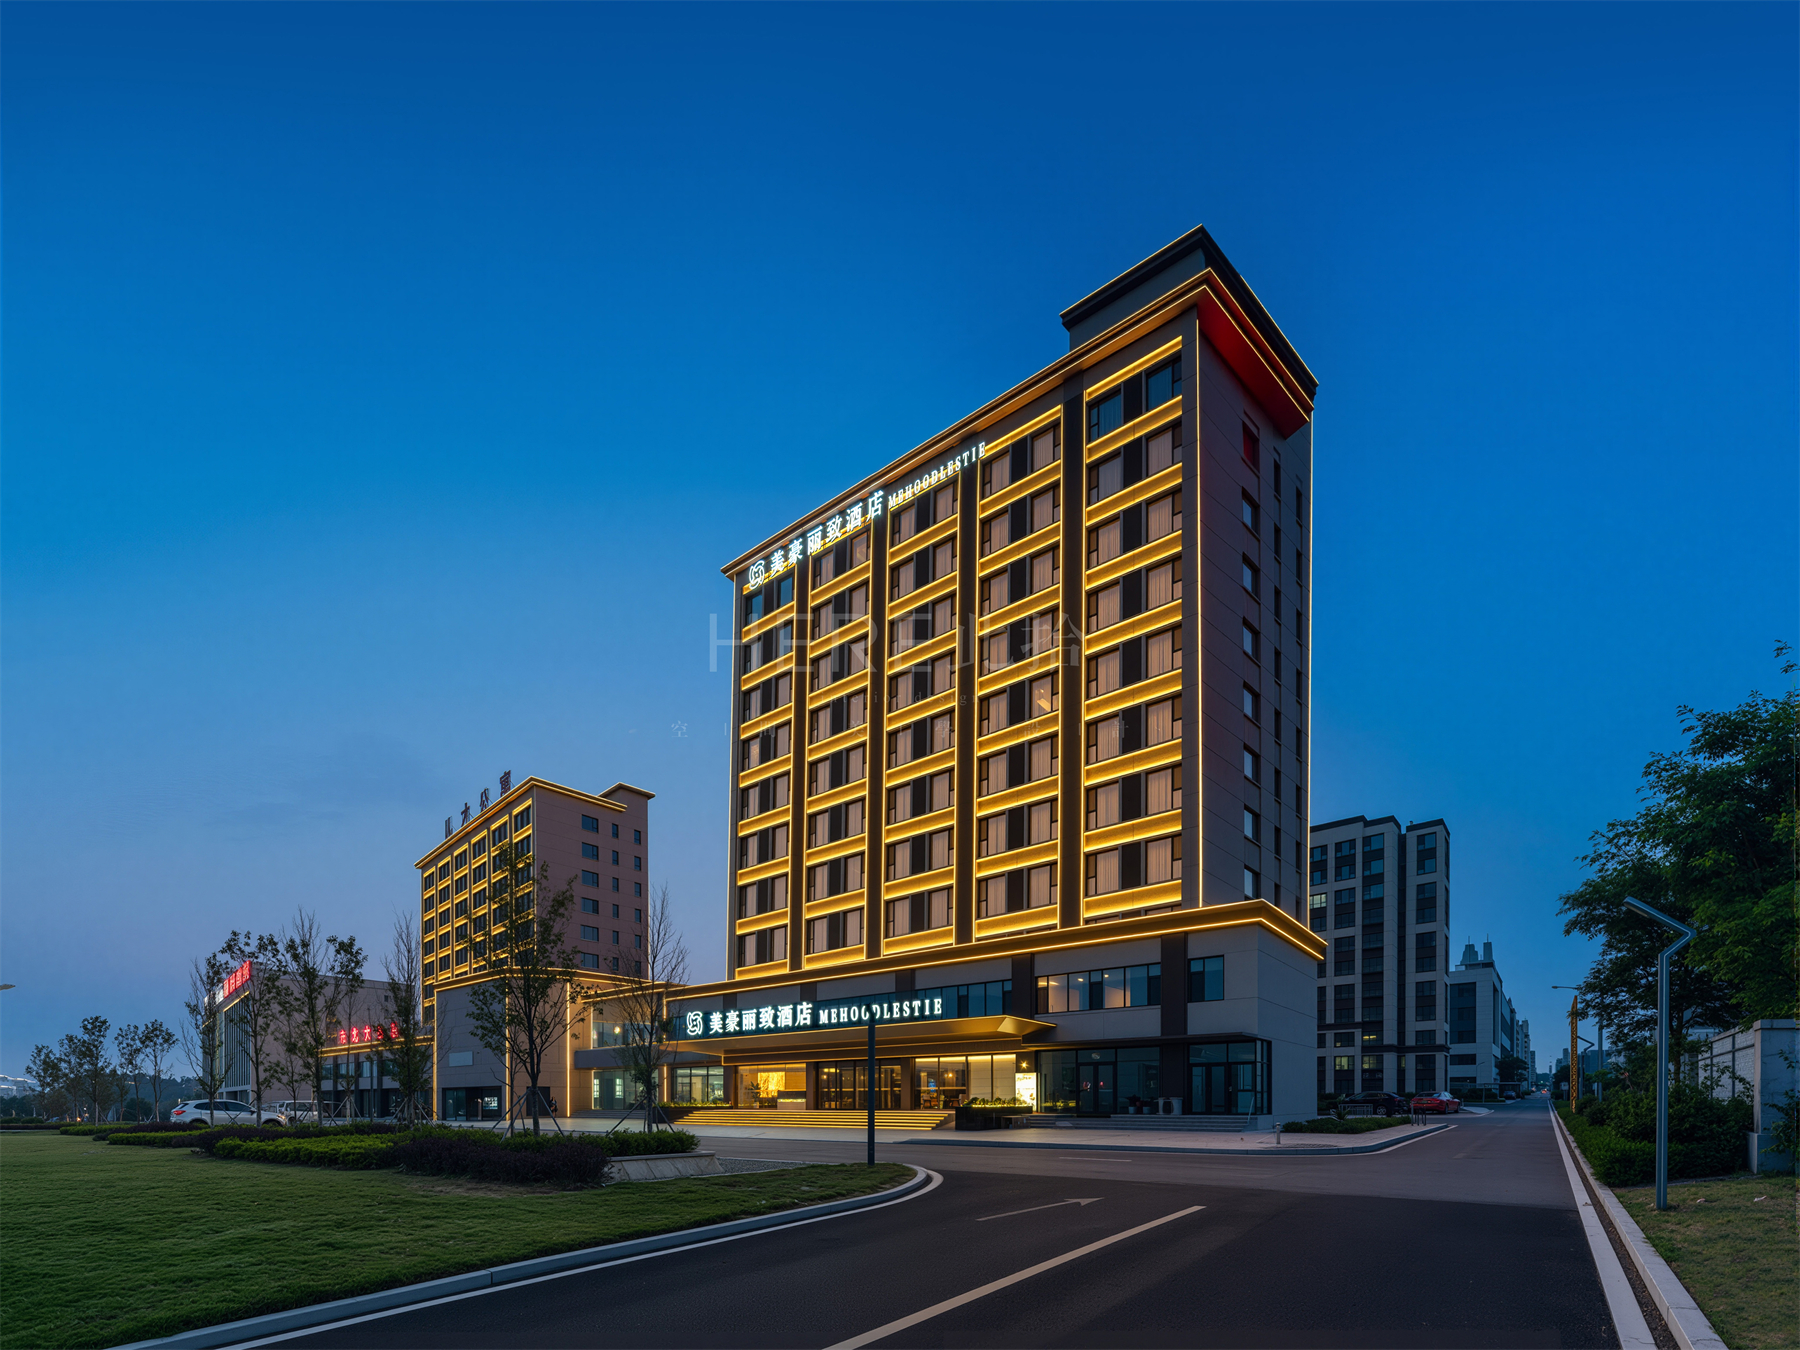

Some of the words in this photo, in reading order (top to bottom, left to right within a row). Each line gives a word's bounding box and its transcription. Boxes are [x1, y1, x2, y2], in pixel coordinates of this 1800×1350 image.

[888, 441, 987, 509] MEHOODLESTIE
[769, 489, 885, 577] 美豪丽致酒店
[709, 1001, 813, 1035] 美豪丽致酒店
